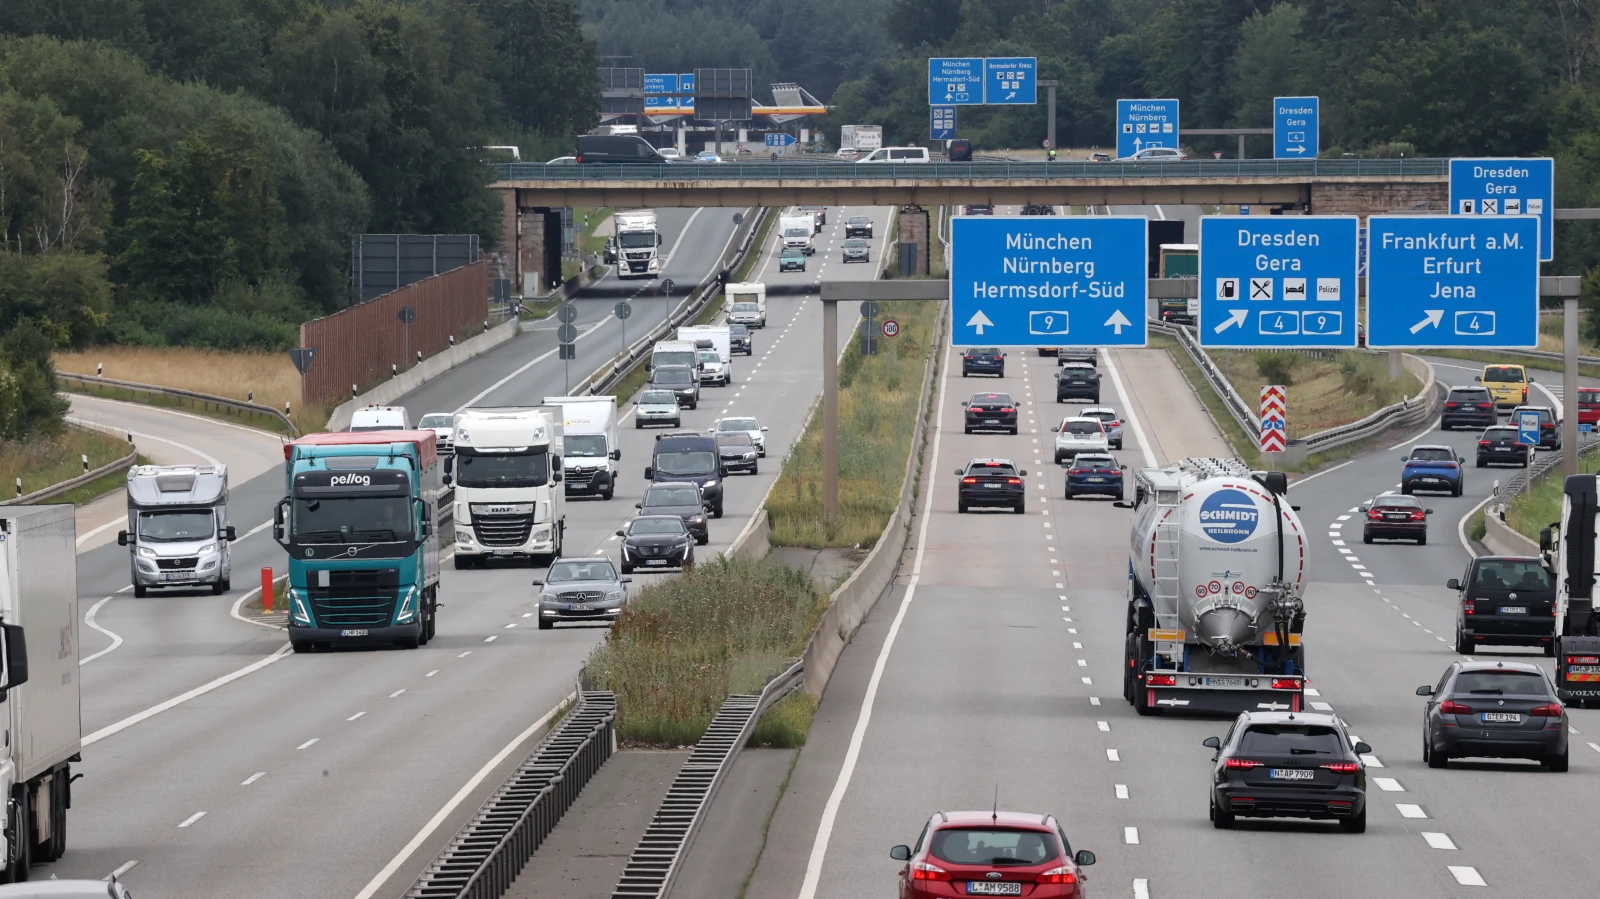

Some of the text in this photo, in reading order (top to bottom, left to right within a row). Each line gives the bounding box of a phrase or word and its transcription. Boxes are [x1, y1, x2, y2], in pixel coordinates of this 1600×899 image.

[1130, 104, 1166, 112] München
[1279, 107, 1313, 115] Dresden
[1129, 114, 1167, 123] Nürnberg
[1286, 118, 1306, 126] Gera
[1473, 166, 1529, 178] Dresden
[1485, 182, 1517, 194] Gera
[1006, 233, 1092, 250] München
[1238, 229, 1320, 246] Dresden
[1382, 232, 1524, 250] Frankfurt a.M.
[1003, 257, 1095, 279] Nürnberg
[1255, 254, 1301, 271] Gera
[1423, 256, 1482, 274] Erfurt
[973, 281, 1125, 298] Hermsdorf-Süd
[1318, 285, 1339, 293] Polizei
[1429, 281, 1476, 298] Jena
[886, 324, 896, 333] 100
[1044, 315, 1054, 330] 9
[1274, 316, 1327, 330] 4 9
[1469, 316, 1480, 330] 4
[1200, 510, 1257, 522] SCHMIDT
[1295, 770, 1313, 778] 7909
[983, 882, 996, 892] AM
[997, 883, 1020, 893] 9588
